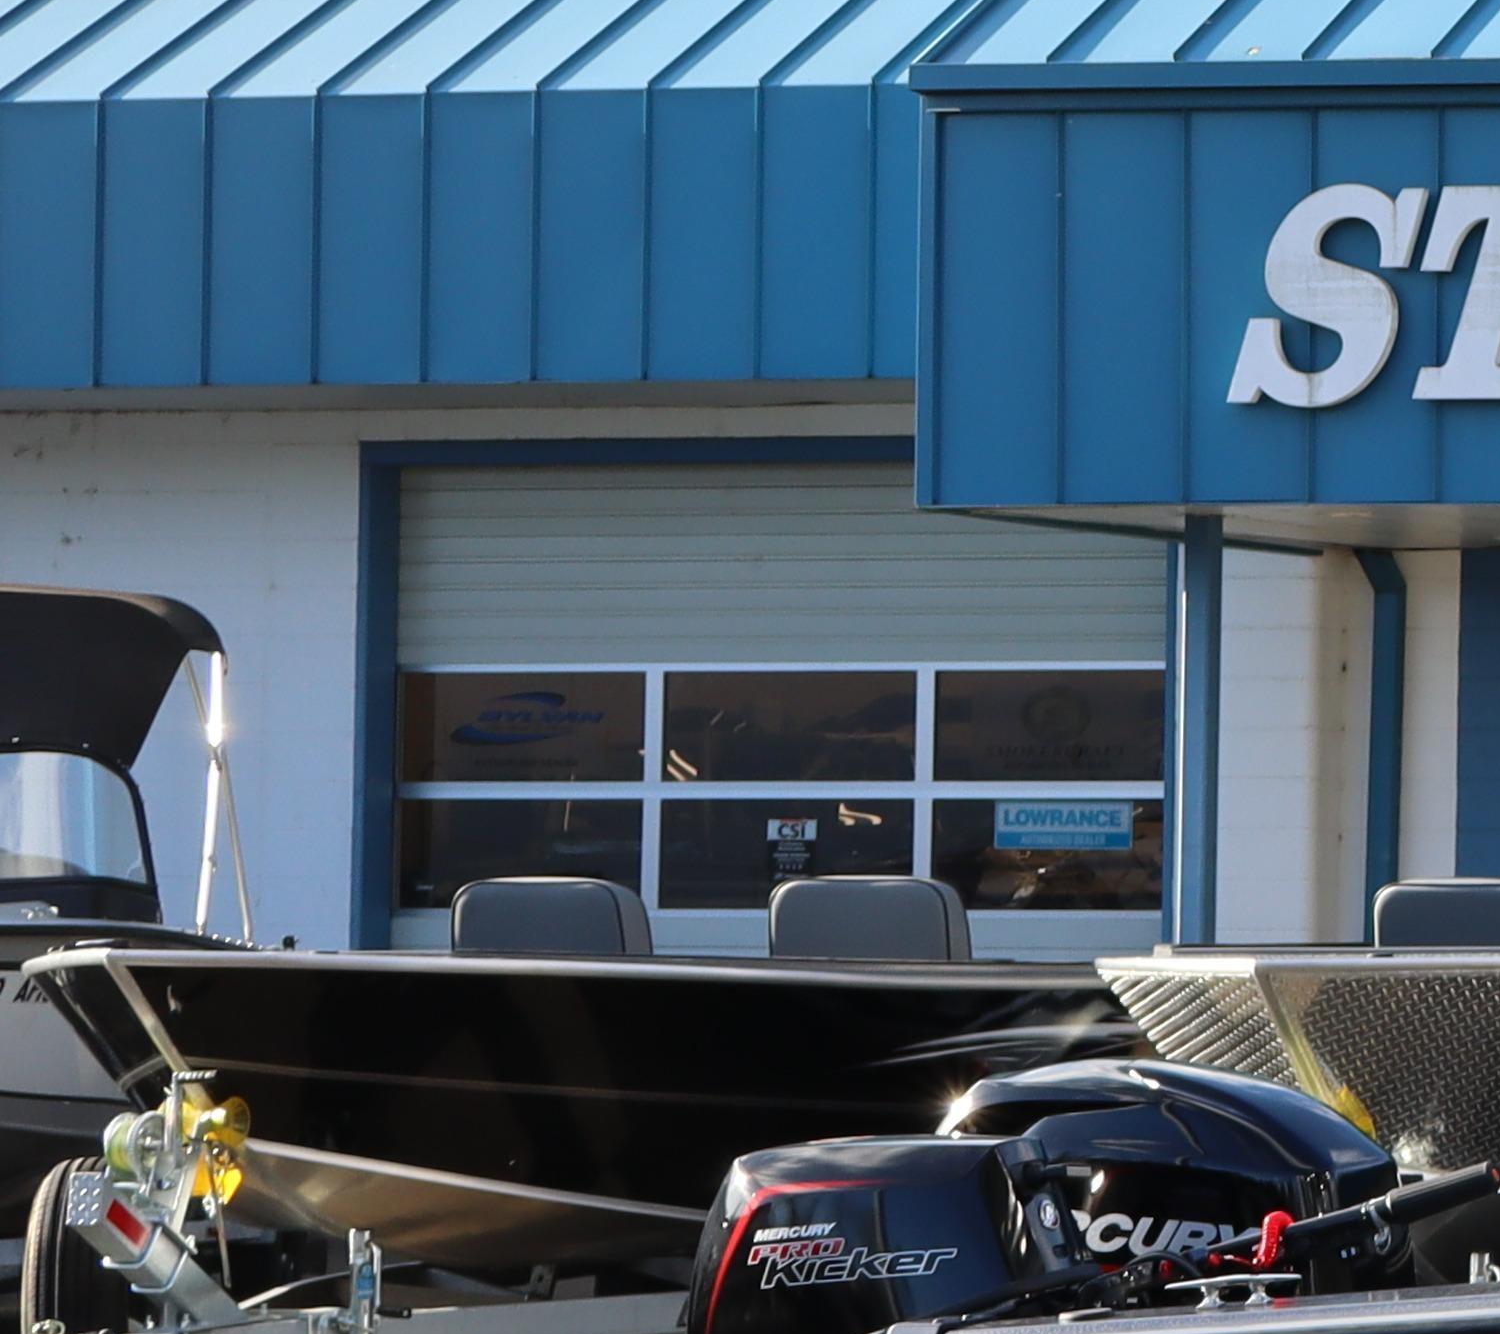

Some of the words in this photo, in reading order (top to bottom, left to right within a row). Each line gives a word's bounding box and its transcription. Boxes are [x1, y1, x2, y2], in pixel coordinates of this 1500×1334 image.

[1003, 808, 1122, 827] LOWRANCE
[753, 1221, 837, 1243] MERCURY
[747, 1237, 846, 1265] PRO
